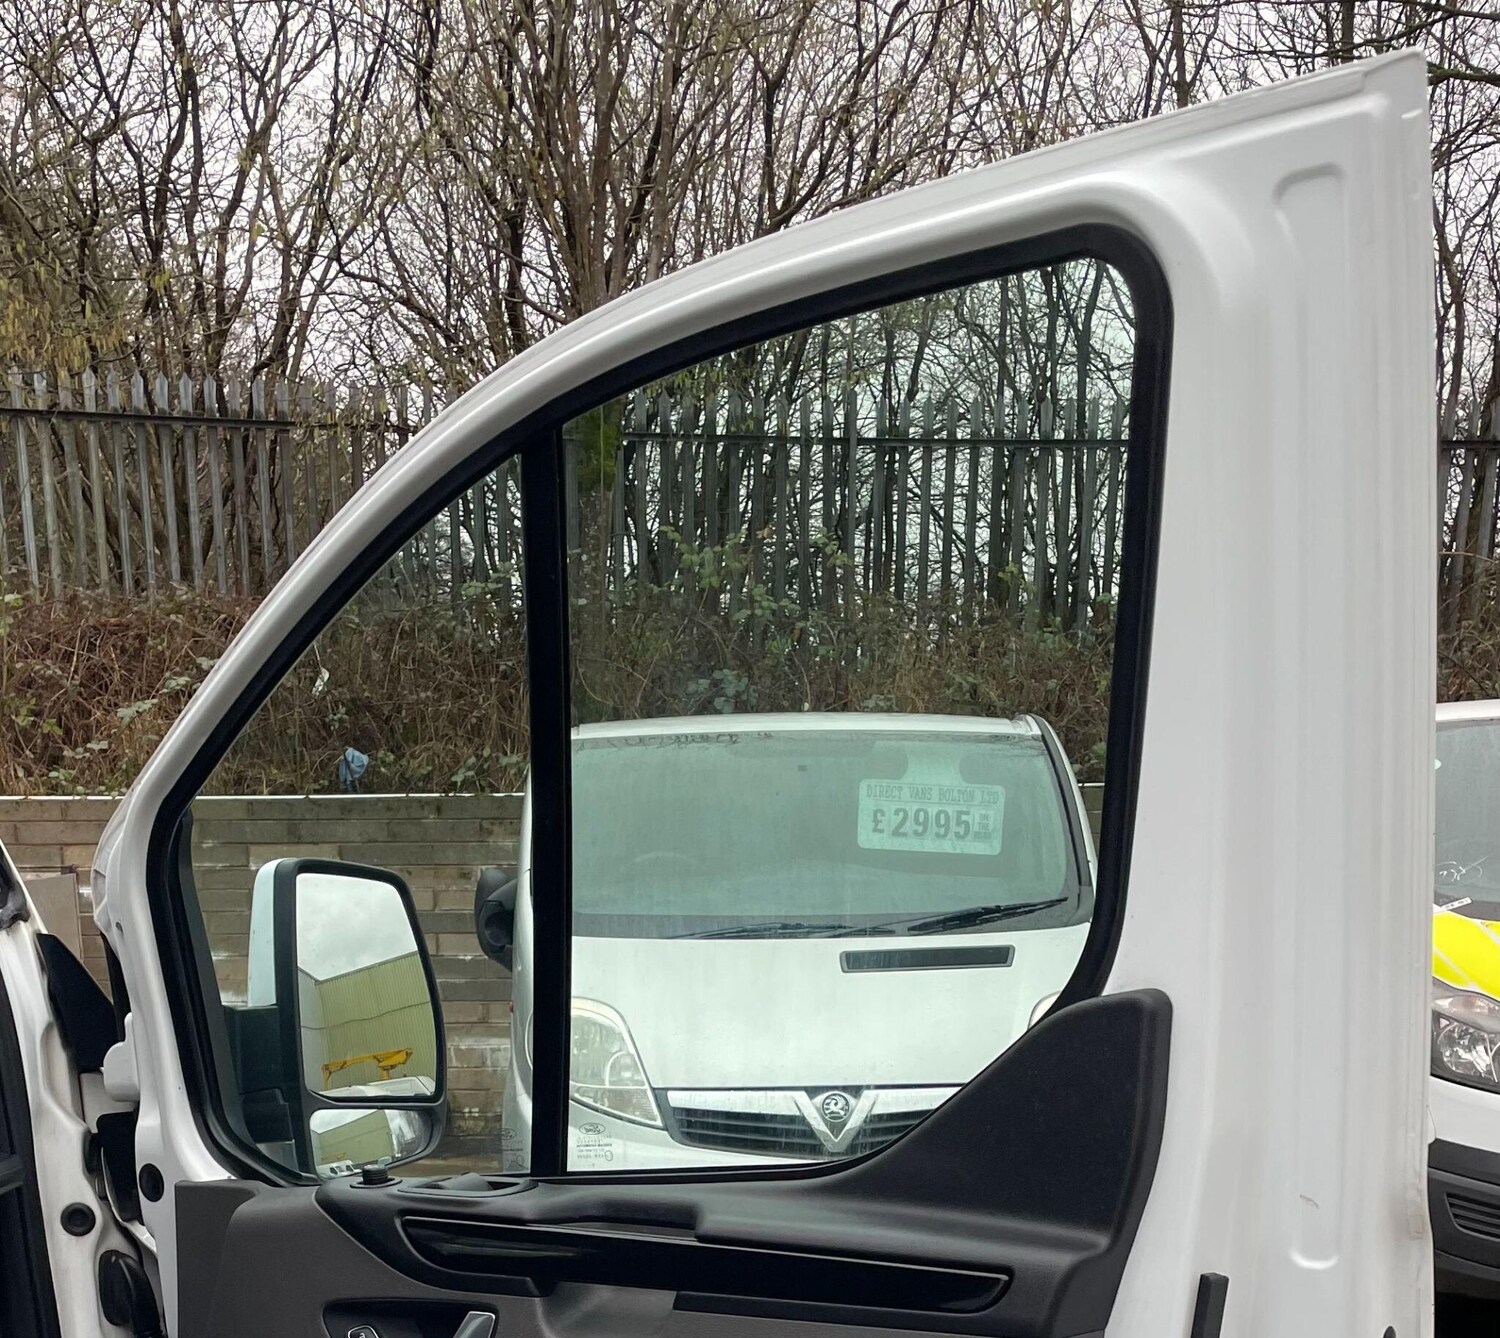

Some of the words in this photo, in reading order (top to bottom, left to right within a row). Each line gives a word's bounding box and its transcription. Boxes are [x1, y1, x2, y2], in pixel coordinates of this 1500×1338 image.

[866, 784, 903, 800] DIRECT
[909, 786, 932, 801] VANS
[938, 788, 975, 803] BOLTON
[980, 790, 1000, 805] LTD
[872, 807, 971, 841] £2995
[978, 822, 990, 831] THE
